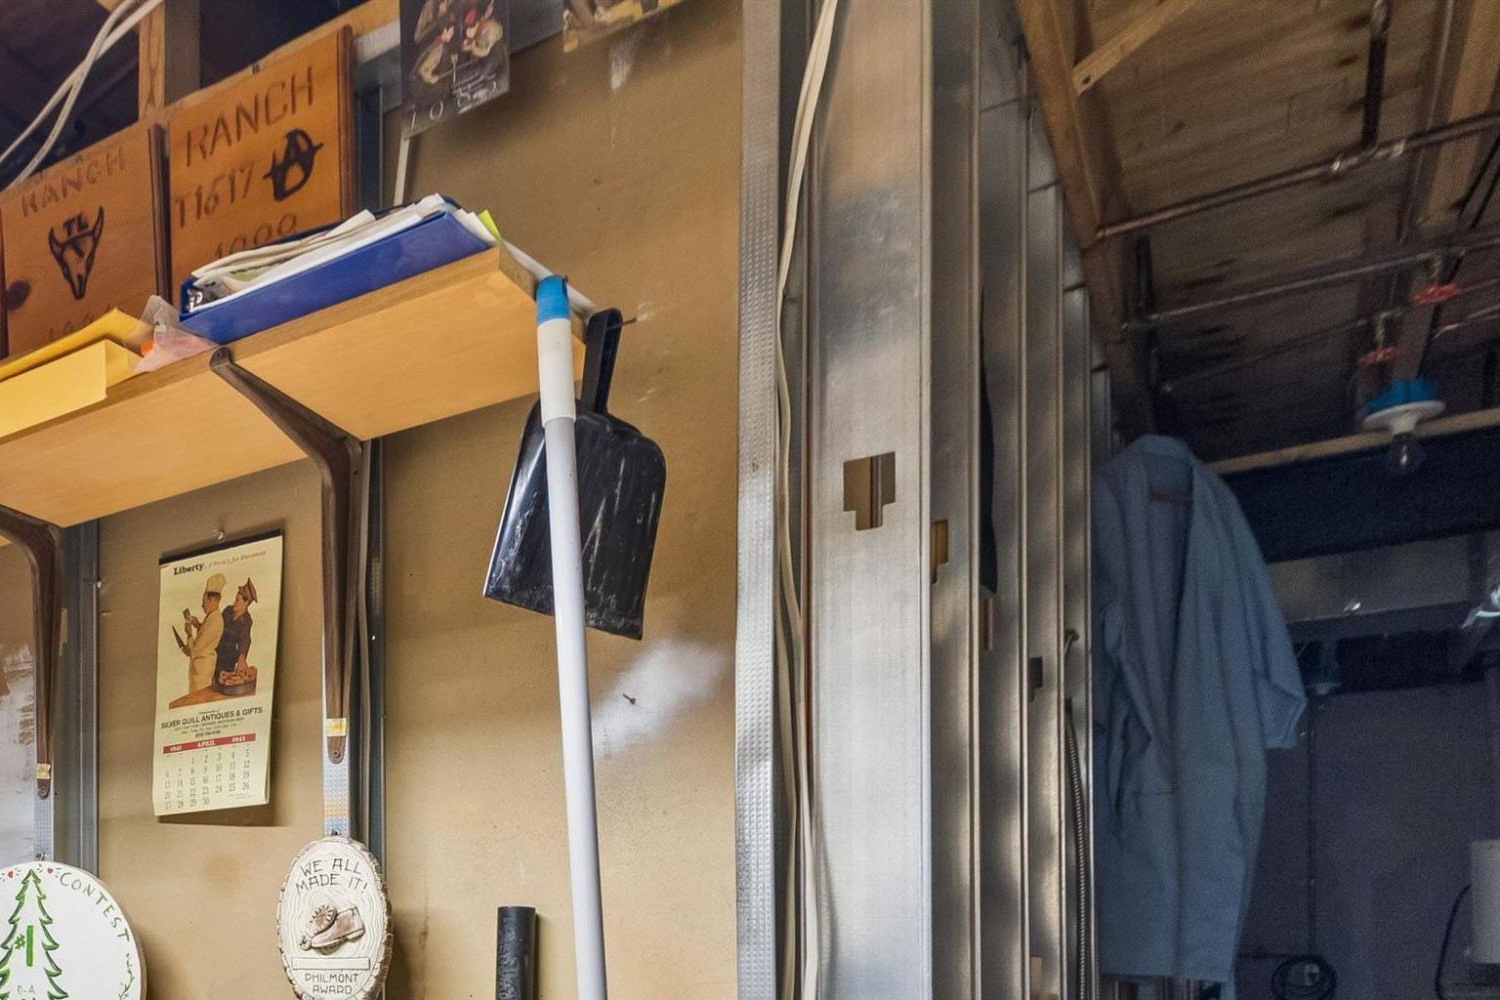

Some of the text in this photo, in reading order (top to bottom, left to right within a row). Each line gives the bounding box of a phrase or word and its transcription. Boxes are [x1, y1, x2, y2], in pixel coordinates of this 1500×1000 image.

[185, 65, 313, 168] RANCH
[21, 147, 126, 218] RANCH
[161, 719, 181, 729] SILVER
[181, 716, 200, 726] QUILL
[201, 711, 235, 722] ANTIQUES
[236, 709, 241, 717] &
[242, 706, 263, 716] GIFTS
[197, 740, 216, 748] APRIL
[300, 858, 362, 877] WE ALL
[296, 873, 368, 895] MADE IT!
[59, 871, 130, 942] CONTEST
[14, 924, 34, 967] #1
[304, 972, 359, 984] PHILMONT
[312, 984, 353, 995] AWARD
